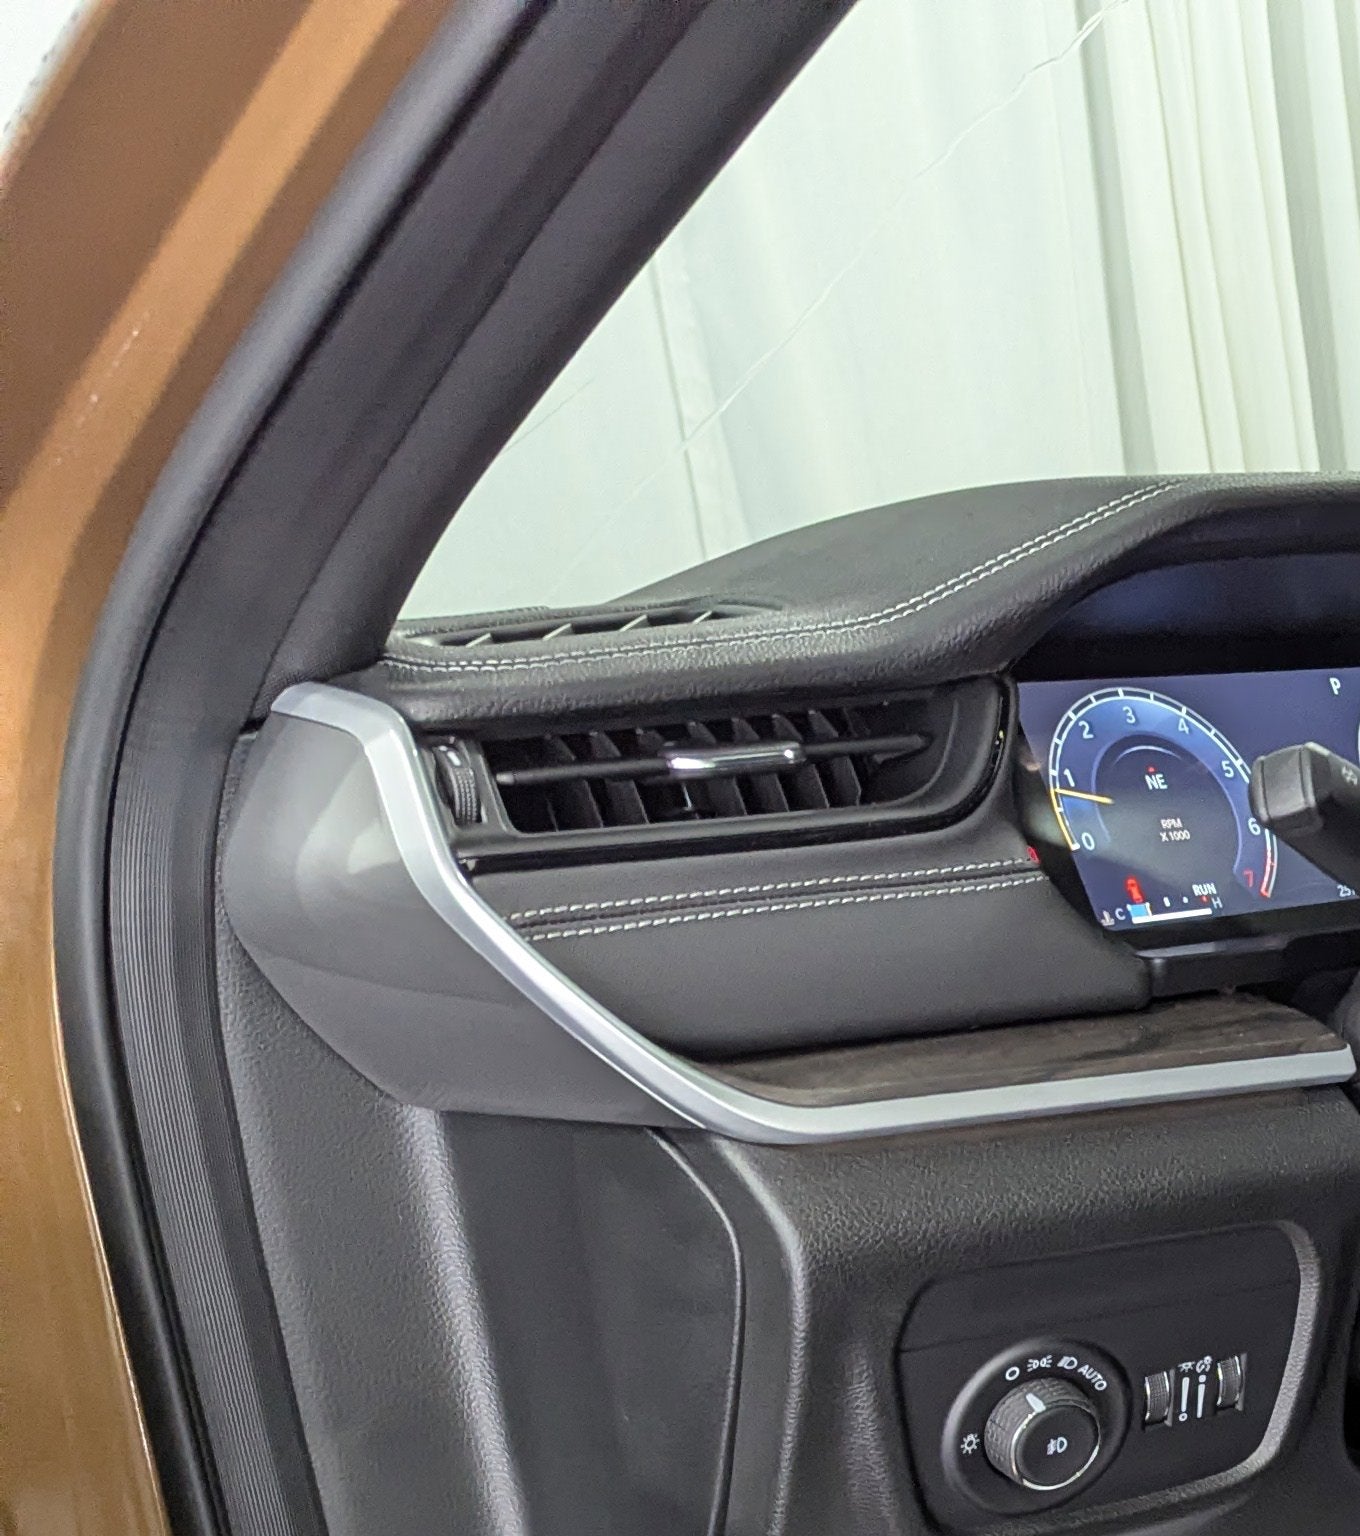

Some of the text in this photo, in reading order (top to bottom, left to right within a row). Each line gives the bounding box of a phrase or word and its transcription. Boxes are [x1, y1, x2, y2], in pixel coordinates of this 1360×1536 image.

[1329, 677, 1341, 695] P
[1122, 706, 1136, 724] 3
[1079, 720, 1094, 739] 2
[1178, 718, 1190, 734] 4
[1063, 767, 1076, 788] 1
[1222, 760, 1235, 778] 5
[1145, 773, 1168, 790] NE
[1160, 818, 1183, 829] RPM
[1248, 817, 1261, 836] 6
[1081, 832, 1095, 851] 0
[1243, 869, 1255, 888] 7
[1192, 882, 1217, 896] RUN
[1211, 896, 1223, 909] H
[1114, 907, 1126, 921] C
[1077, 1364, 1108, 1392] AUTO
